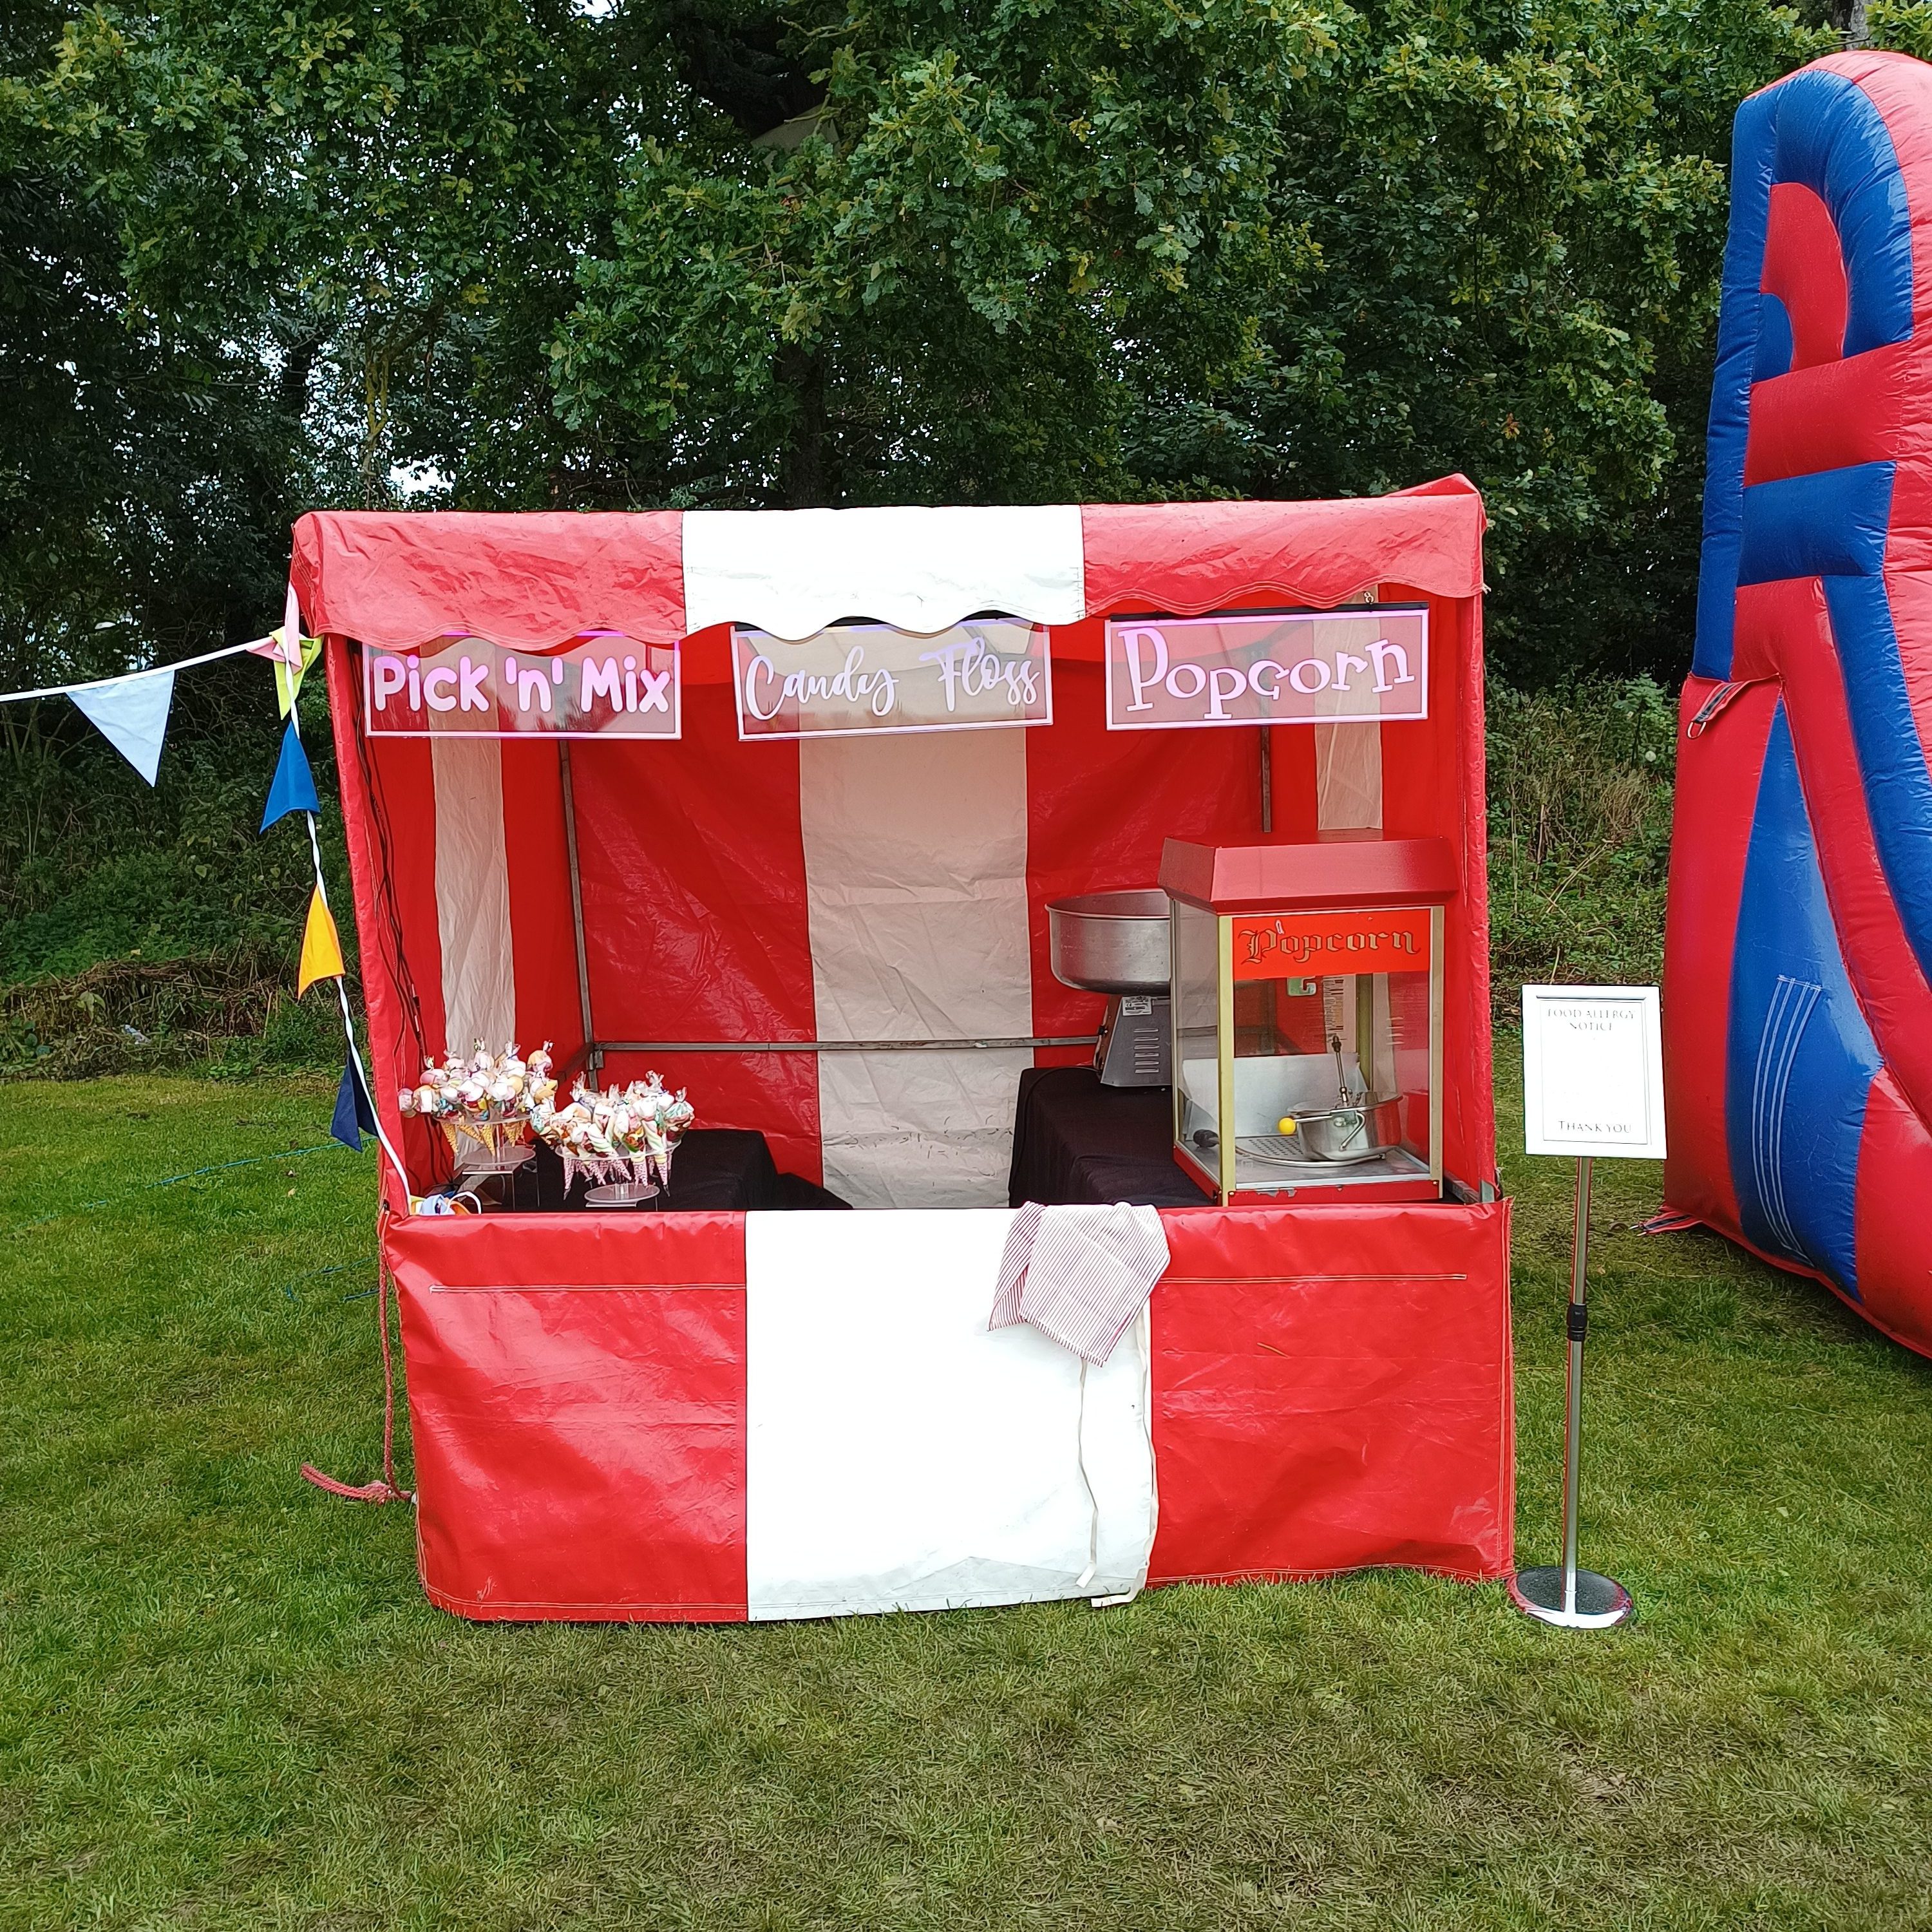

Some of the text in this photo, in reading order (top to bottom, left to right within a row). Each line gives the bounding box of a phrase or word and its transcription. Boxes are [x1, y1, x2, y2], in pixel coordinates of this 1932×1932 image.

[372, 654, 671, 713] Pick 'n' Mix
[745, 636, 1041, 720] Candy Floss
[1117, 626, 1416, 719] Popcorn
[1237, 927, 1422, 965] Popcorn
[1548, 1008, 1635, 1019] FOOD ALLERGY
[1557, 1121, 1632, 1133] THANK YOU
